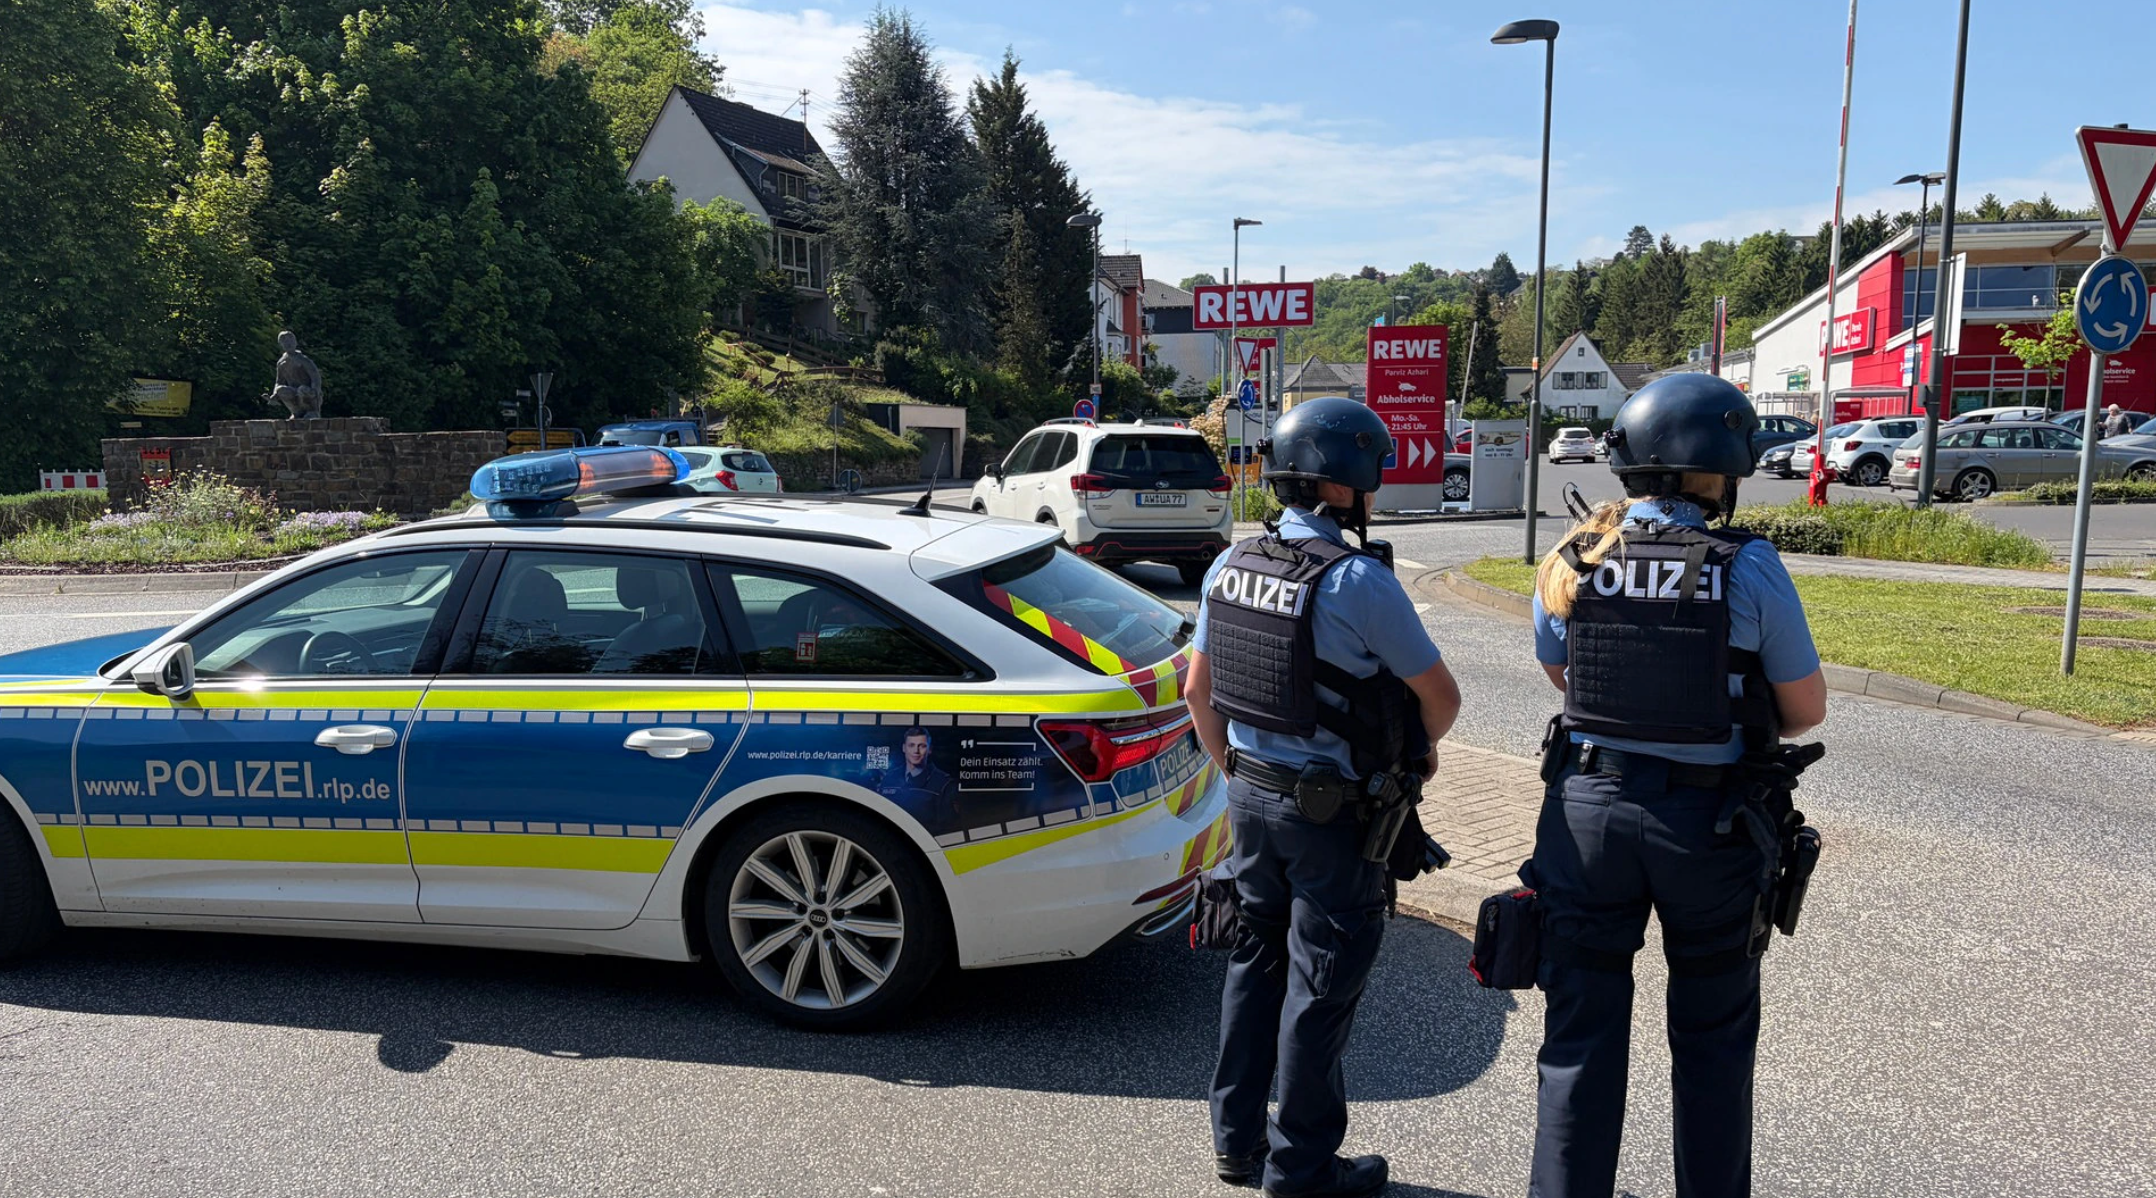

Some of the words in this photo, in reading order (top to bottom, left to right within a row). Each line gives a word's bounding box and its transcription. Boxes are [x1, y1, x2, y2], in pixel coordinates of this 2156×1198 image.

[1199, 289, 1308, 323] REWE
[1373, 339, 1442, 360] REWE
[1377, 394, 1436, 404] Abholservice
[1391, 414, 1420, 422] Mo.-Sa.
[1413, 422, 1428, 431] Uhr
[1172, 495, 1183, 504] 77
[747, 750, 862, 760] www.polizei.rlp.de/karriere
[960, 757, 981, 767] Dein
[983, 757, 1016, 767] Einsatz
[1018, 756, 1043, 766] zählt.
[959, 770, 989, 780] Komm
[991, 769, 1006, 779] ins
[1007, 770, 1036, 779] Team!
[83, 759, 391, 804] www.POLIZEI.rlp.de
